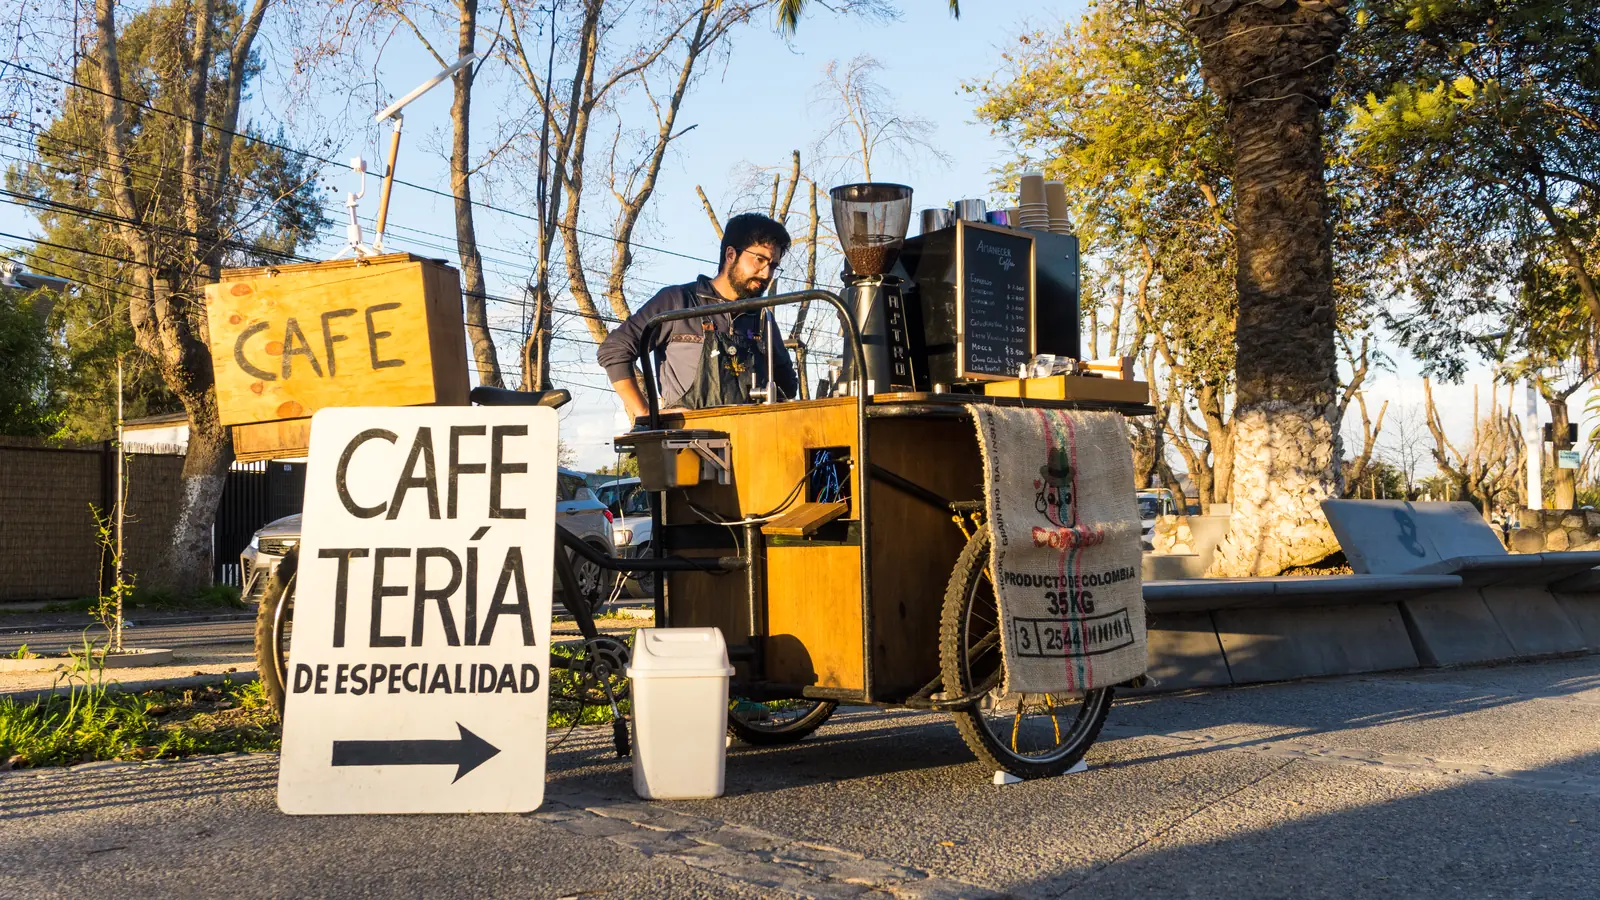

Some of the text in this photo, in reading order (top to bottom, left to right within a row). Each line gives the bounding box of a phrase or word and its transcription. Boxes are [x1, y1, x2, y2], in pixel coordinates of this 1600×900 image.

[976, 239, 1012, 257] AMANECER
[233, 302, 406, 382] CAFE
[888, 294, 906, 376] ASTRO
[335, 424, 529, 521] CAFE
[994, 489, 1002, 511] PRO
[996, 513, 1009, 546] GRAIN
[318, 526, 536, 649] TERÍA
[1004, 572, 1068, 588] PRODUCTO
[1082, 566, 1135, 588] COLOMBIA
[1020, 626, 1031, 650] 3
[1043, 627, 1082, 650] 2544
[293, 662, 541, 696] DE ESPECIALIDAD
